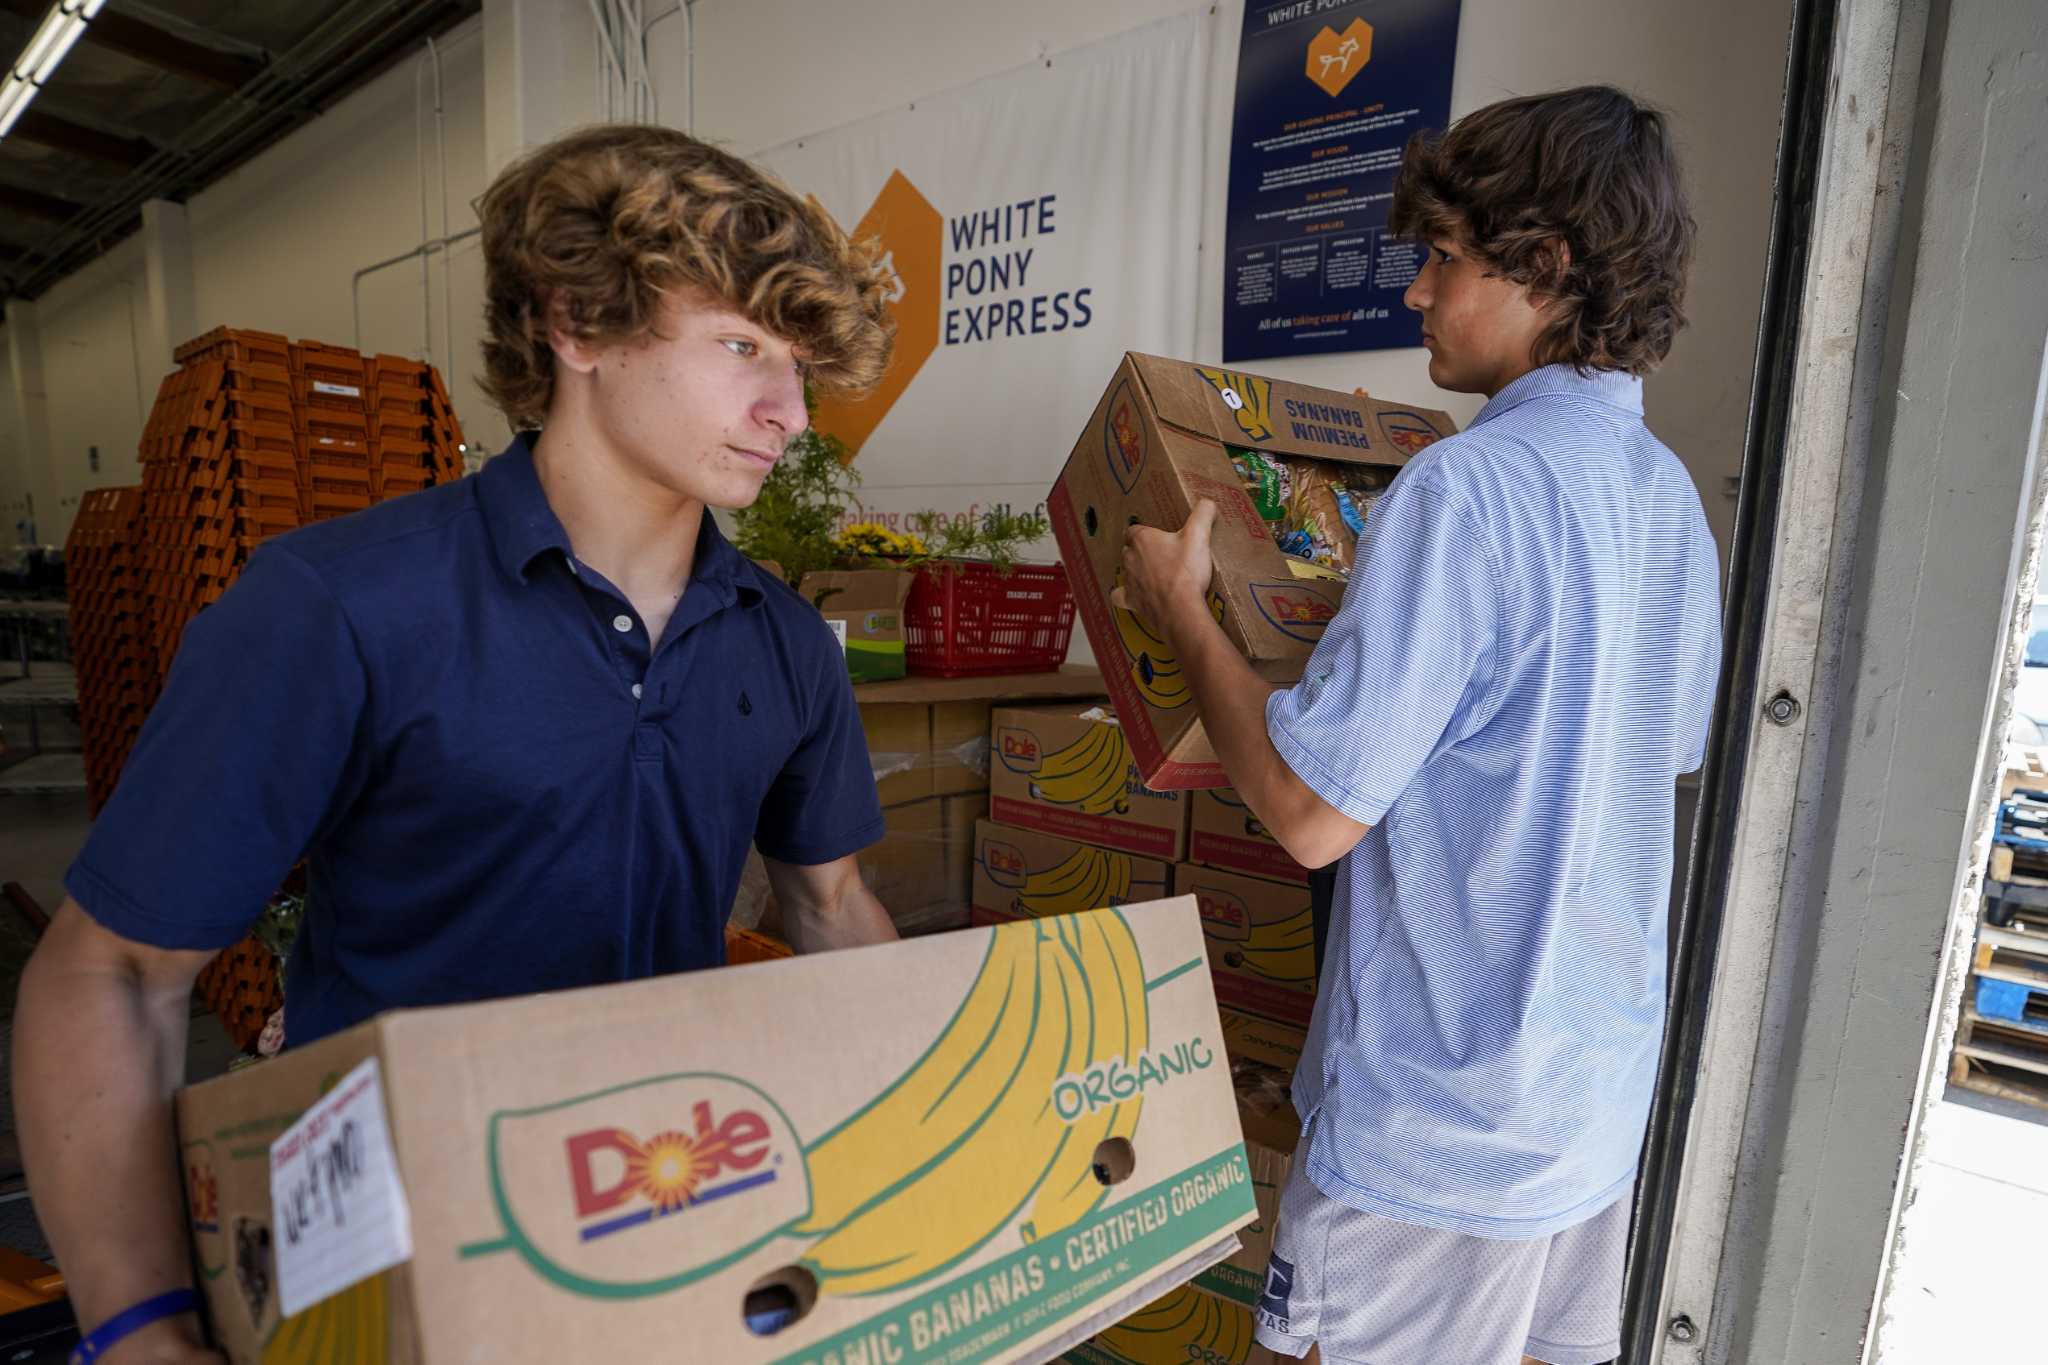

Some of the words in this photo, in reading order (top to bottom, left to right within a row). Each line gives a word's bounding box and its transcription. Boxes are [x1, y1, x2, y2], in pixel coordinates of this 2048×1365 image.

[1267, 0, 1313, 25] WHITE
[950, 195, 1057, 253] WHITE
[947, 248, 1035, 300] PONY
[944, 287, 1093, 346] EXPRESS
[1352, 309, 1365, 321] all
[1365, 307, 1378, 319] of
[1378, 308, 1389, 318] us
[1284, 399, 1363, 428] BANANAS
[1291, 422, 1371, 449] PREMIUM
[1004, 735, 1037, 757] Dole
[1053, 1037, 1213, 1120] ORGANIC
[565, 1099, 772, 1219] Dole
[908, 1255, 1045, 1351] BANANAS
[1065, 1198, 1169, 1272] CERTIFIED
[1173, 1160, 1246, 1217] ORGANIC
